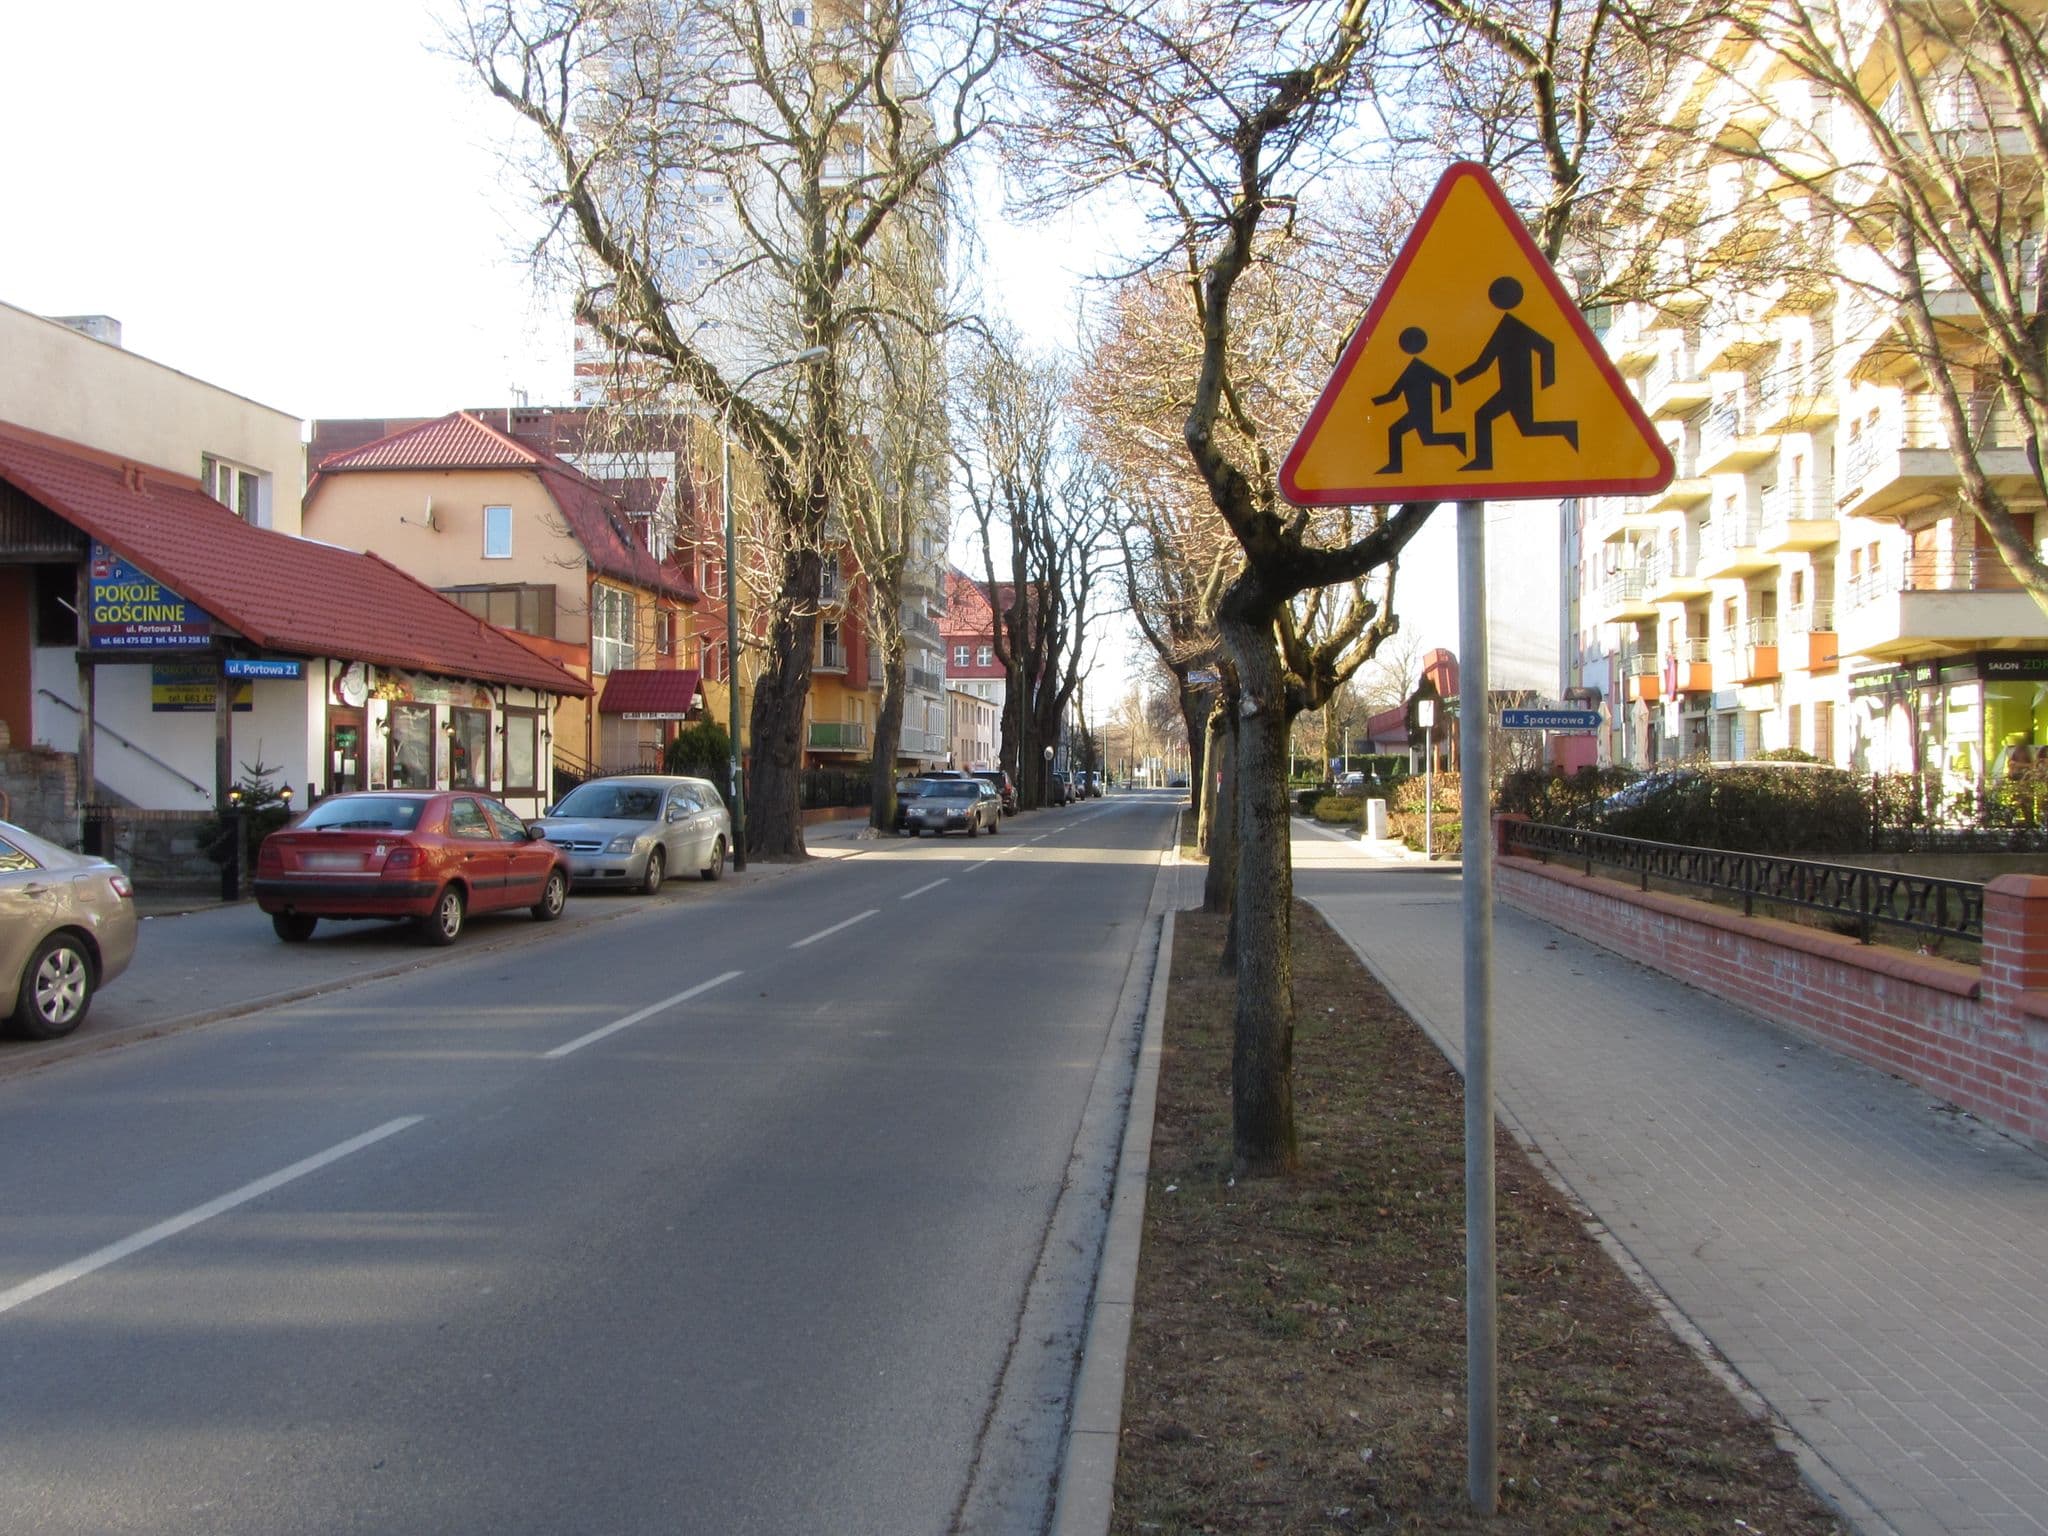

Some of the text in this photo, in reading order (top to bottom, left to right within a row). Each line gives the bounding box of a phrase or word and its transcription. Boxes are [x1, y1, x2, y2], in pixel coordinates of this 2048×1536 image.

[95, 585, 161, 603] POKOJE
[94, 602, 185, 623] GOŚCINNE
[126, 624, 182, 633] ul. Portowa 21
[229, 664, 298, 675] ul. Portowa 21
[1988, 662, 2019, 670] SALON
[1505, 714, 1595, 726] ul. Spacerowa 2
